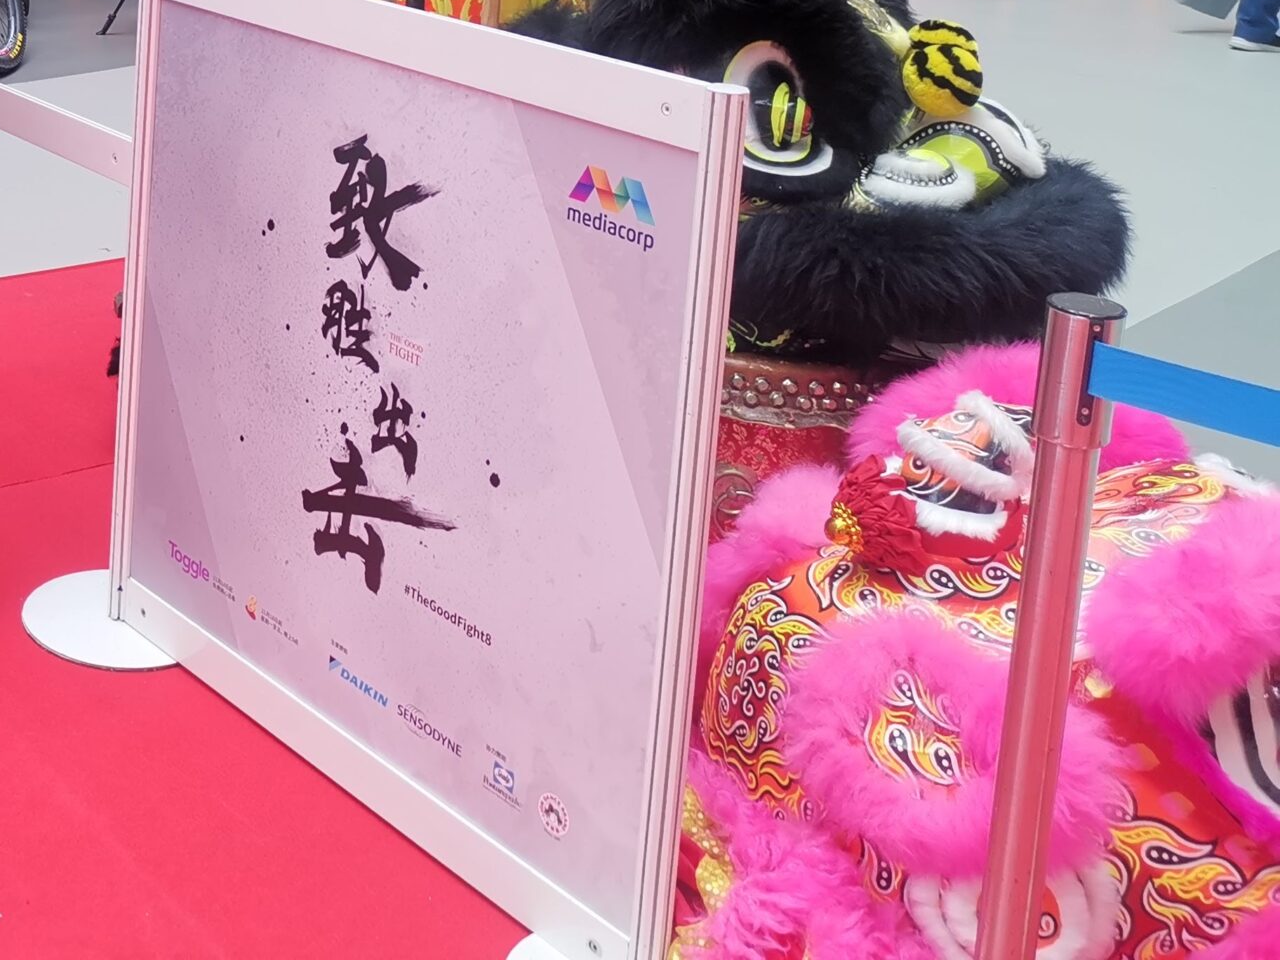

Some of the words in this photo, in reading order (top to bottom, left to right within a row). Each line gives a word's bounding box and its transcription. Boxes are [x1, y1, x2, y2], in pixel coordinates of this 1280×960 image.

[566, 203, 655, 252] mediacorp
[389, 342, 422, 366] FIGHT
[404, 339, 424, 353] GOOD
[168, 540, 210, 582] Toggle
[404, 584, 492, 646] #TheGoodFight8
[340, 667, 388, 708] DAIKIN
[396, 703, 463, 758] SENSODYNE
